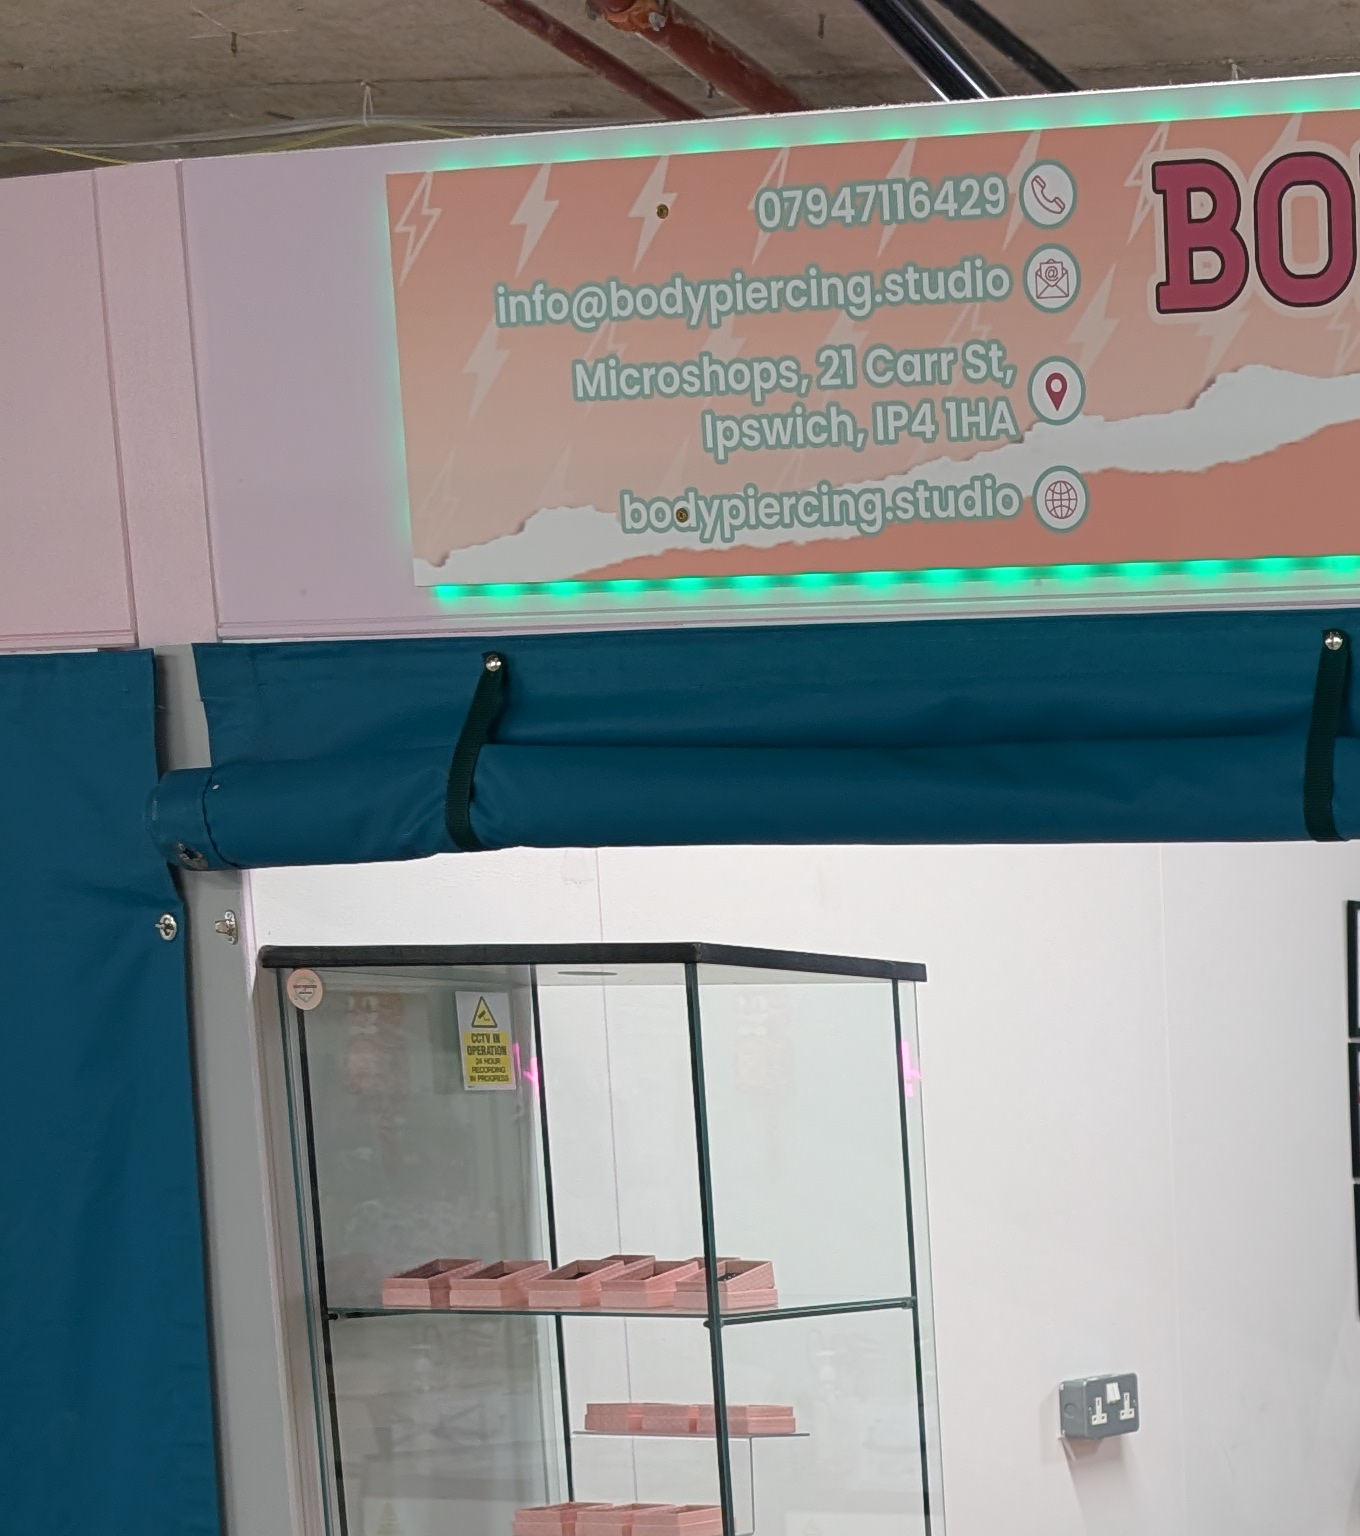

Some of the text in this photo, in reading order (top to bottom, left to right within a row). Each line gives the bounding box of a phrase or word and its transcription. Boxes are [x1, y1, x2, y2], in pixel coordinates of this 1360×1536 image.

[757, 176, 1006, 228] 07947116429
[497, 259, 1011, 326] info@bodypiercing.studio
[574, 342, 1017, 399] Microshops, 21 Carr St,
[704, 400, 1019, 461] Ipswich, IP4 1HA
[621, 479, 1023, 541] bodypiercing.studio
[467, 1045, 507, 1056] OPERATION
[471, 1033, 490, 1044] CCTV
